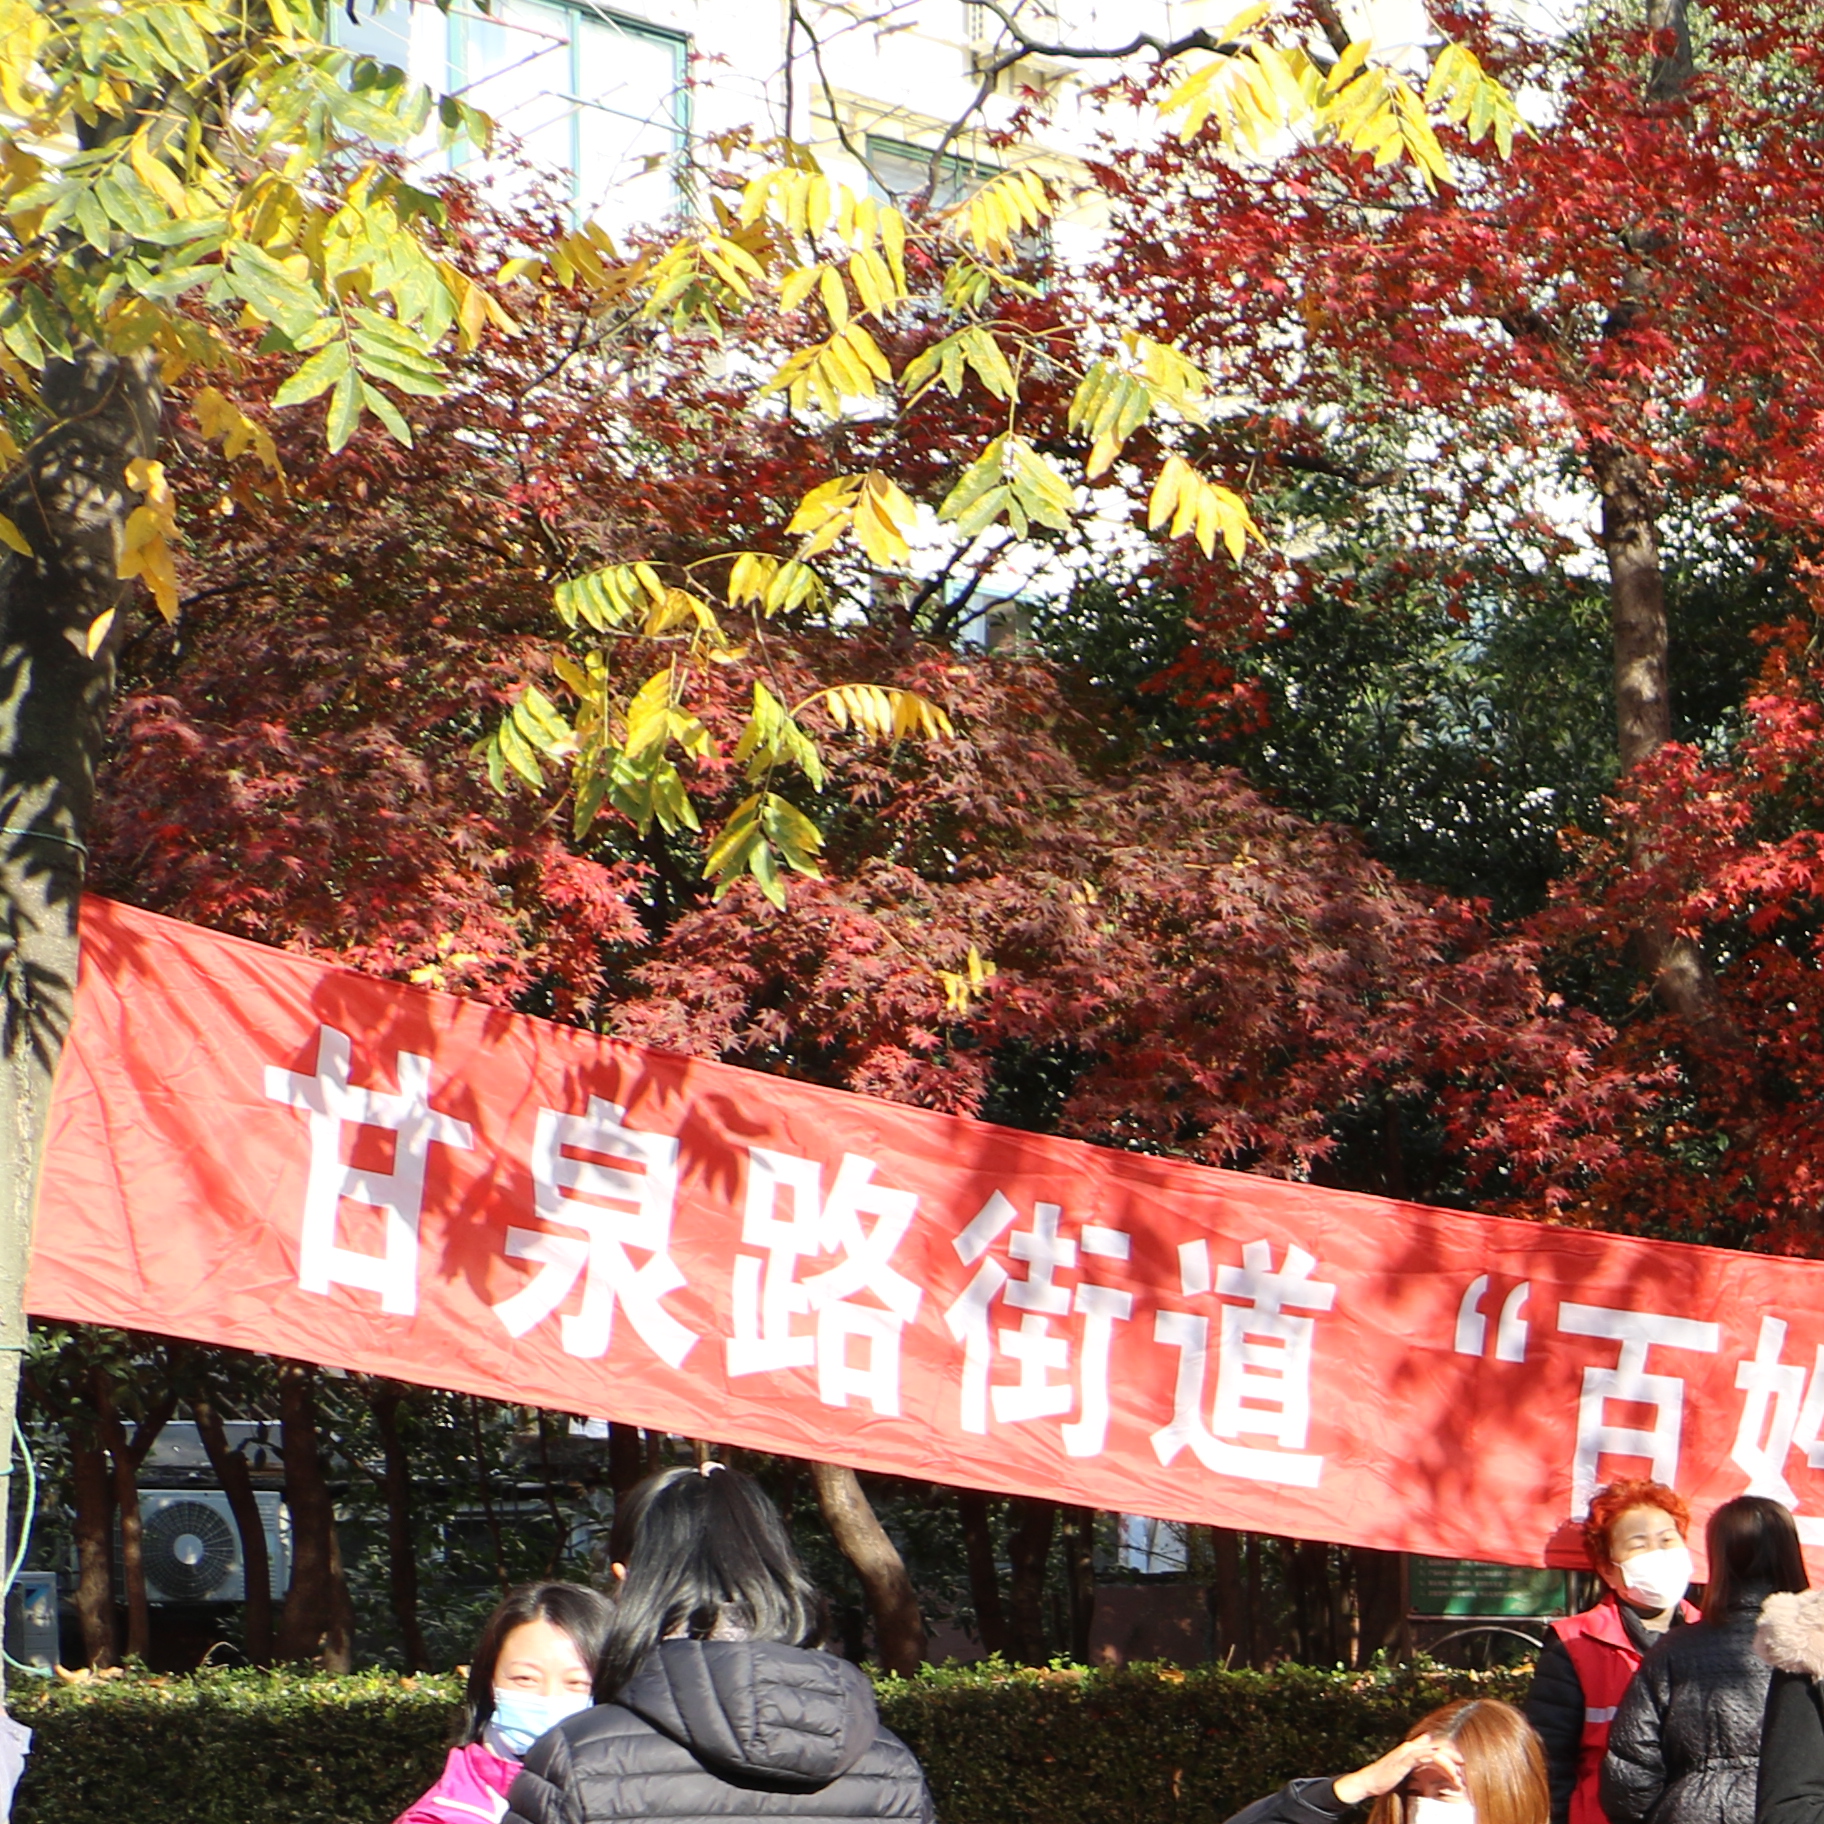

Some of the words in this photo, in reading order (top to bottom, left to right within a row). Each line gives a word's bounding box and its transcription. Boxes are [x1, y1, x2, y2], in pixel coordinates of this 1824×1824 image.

[265, 1023, 1336, 1489] 甘泉路街道
